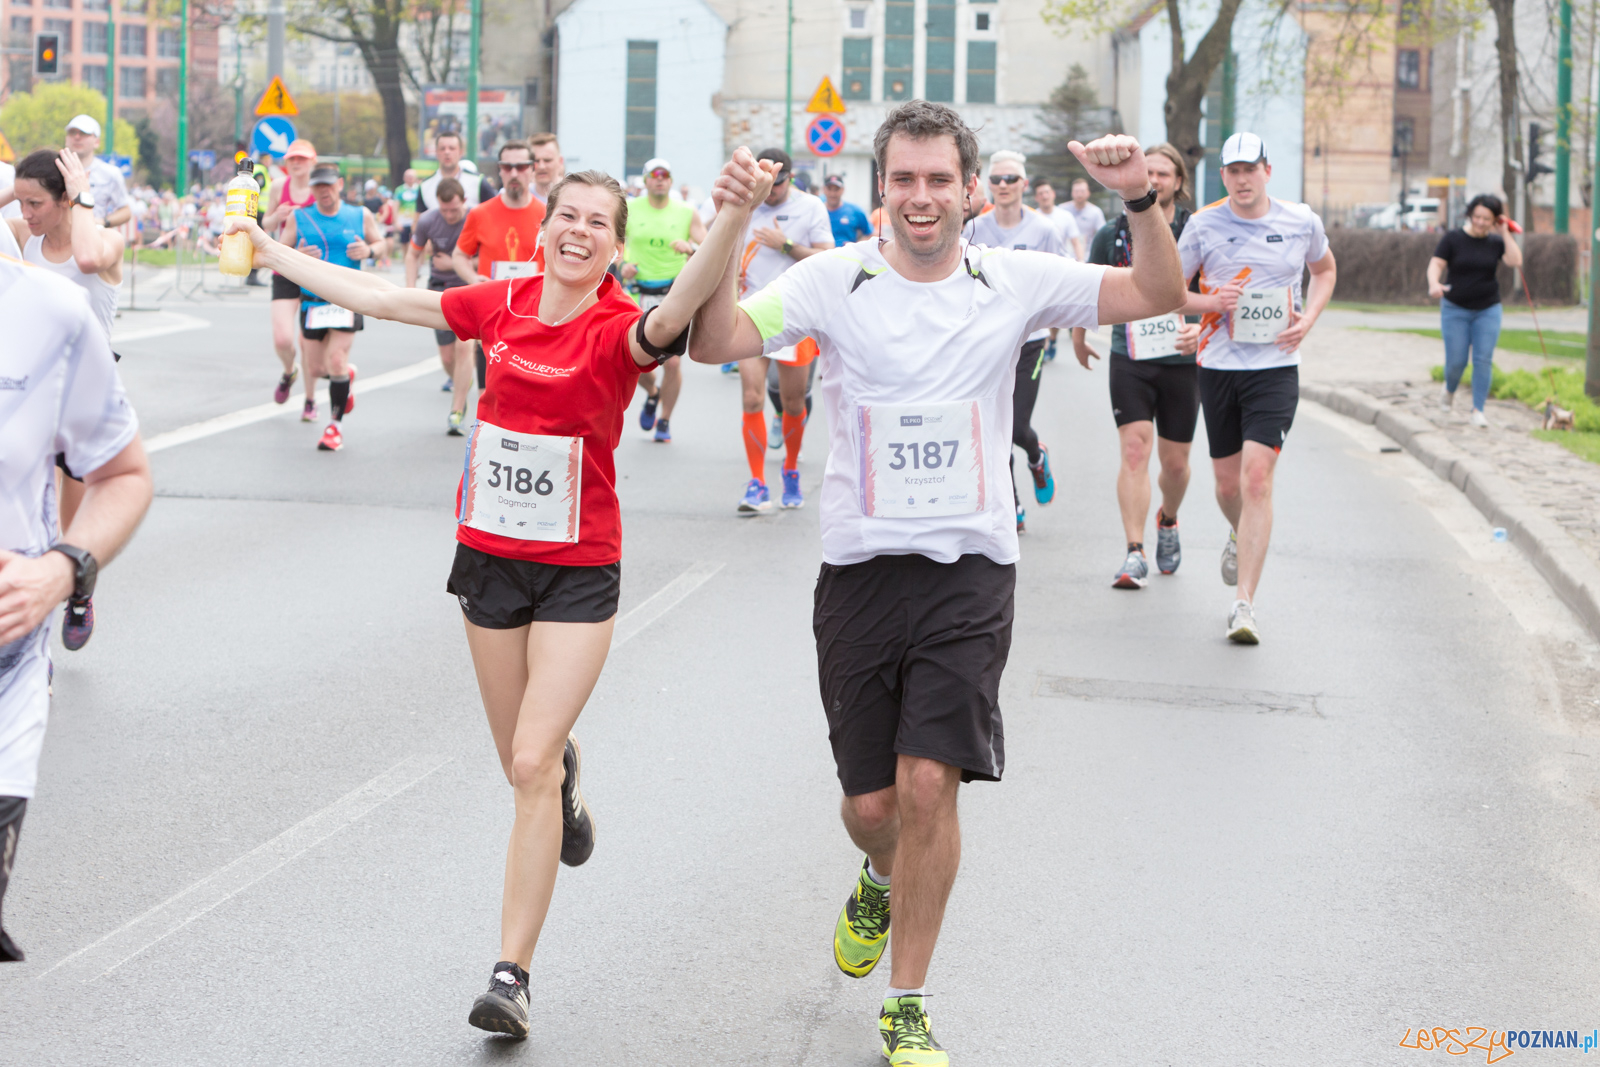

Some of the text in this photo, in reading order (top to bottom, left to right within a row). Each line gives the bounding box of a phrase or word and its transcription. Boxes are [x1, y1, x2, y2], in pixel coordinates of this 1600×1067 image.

[1241, 305, 1283, 320] 2606
[1139, 320, 1176, 336] 3250
[888, 440, 959, 471] 3187
[487, 460, 554, 496] 3186
[904, 475, 946, 487] Krzysztof
[498, 496, 537, 510] Dagmara
